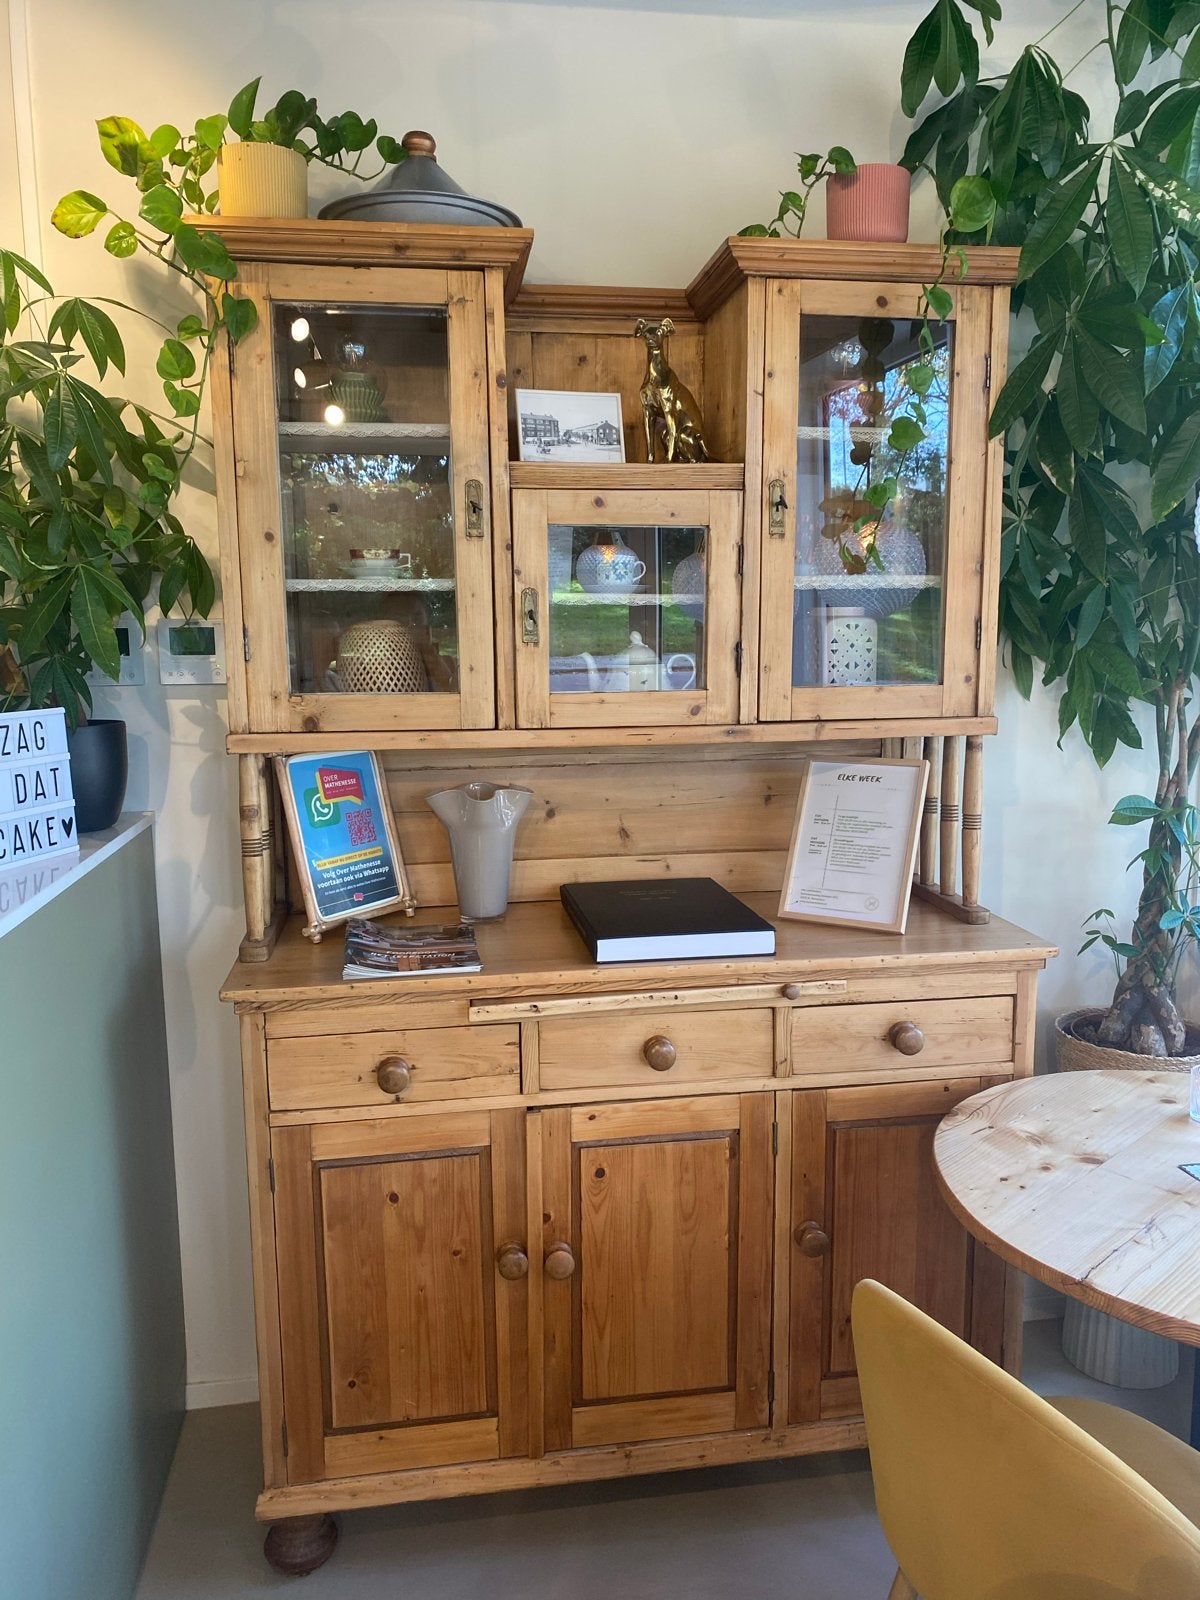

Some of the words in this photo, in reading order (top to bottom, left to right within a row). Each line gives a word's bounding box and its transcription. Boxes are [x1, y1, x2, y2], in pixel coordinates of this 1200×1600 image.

[0, 721, 45, 756] ZAG
[15, 768, 59, 804] DAT
[323, 774, 338, 783] OVER
[324, 778, 357, 788] MATHENESSE
[838, 773, 858, 782] ELKE
[317, 878, 343, 888] voortaan
[363, 866, 389, 877] Whatsapp
[322, 870, 336, 878] Volg
[336, 867, 350, 876] Over
[350, 860, 381, 872] Mathenesse
